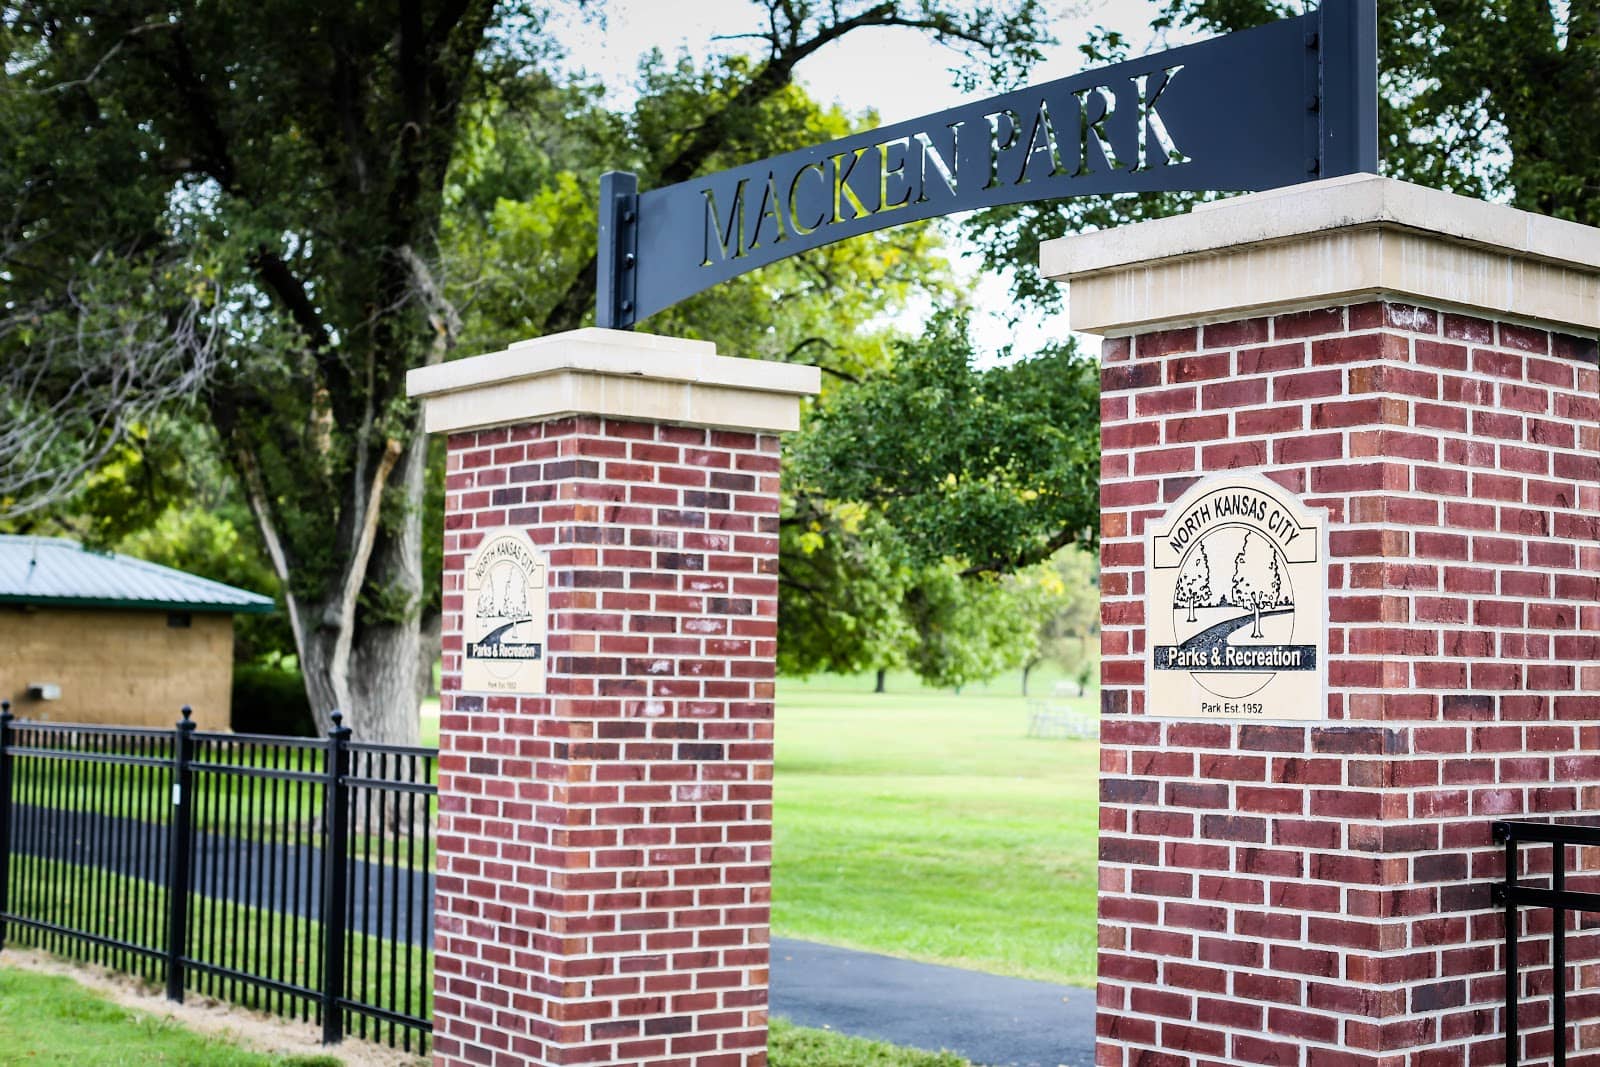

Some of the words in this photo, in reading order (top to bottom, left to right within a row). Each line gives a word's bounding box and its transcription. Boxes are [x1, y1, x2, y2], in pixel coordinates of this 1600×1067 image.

[700, 121, 964, 267] MACKEN
[982, 64, 1192, 190] PARK
[1169, 503, 1211, 553] NORTH
[1214, 495, 1267, 521] KANSAS
[1268, 510, 1300, 547] CITY
[475, 550, 496, 581] NORTH
[497, 542, 522, 559] KANSAS
[520, 552, 536, 577] CITY
[472, 643, 491, 658] Parks
[492, 643, 498, 658] &
[499, 643, 535, 658] Recreation
[1168, 646, 1207, 667] Parks
[1210, 647, 1223, 667] &
[1225, 646, 1301, 667] Recreation
[1201, 702, 1221, 714] Park
[1224, 703, 1241, 714] Est.
[1243, 703, 1263, 714] 1952
